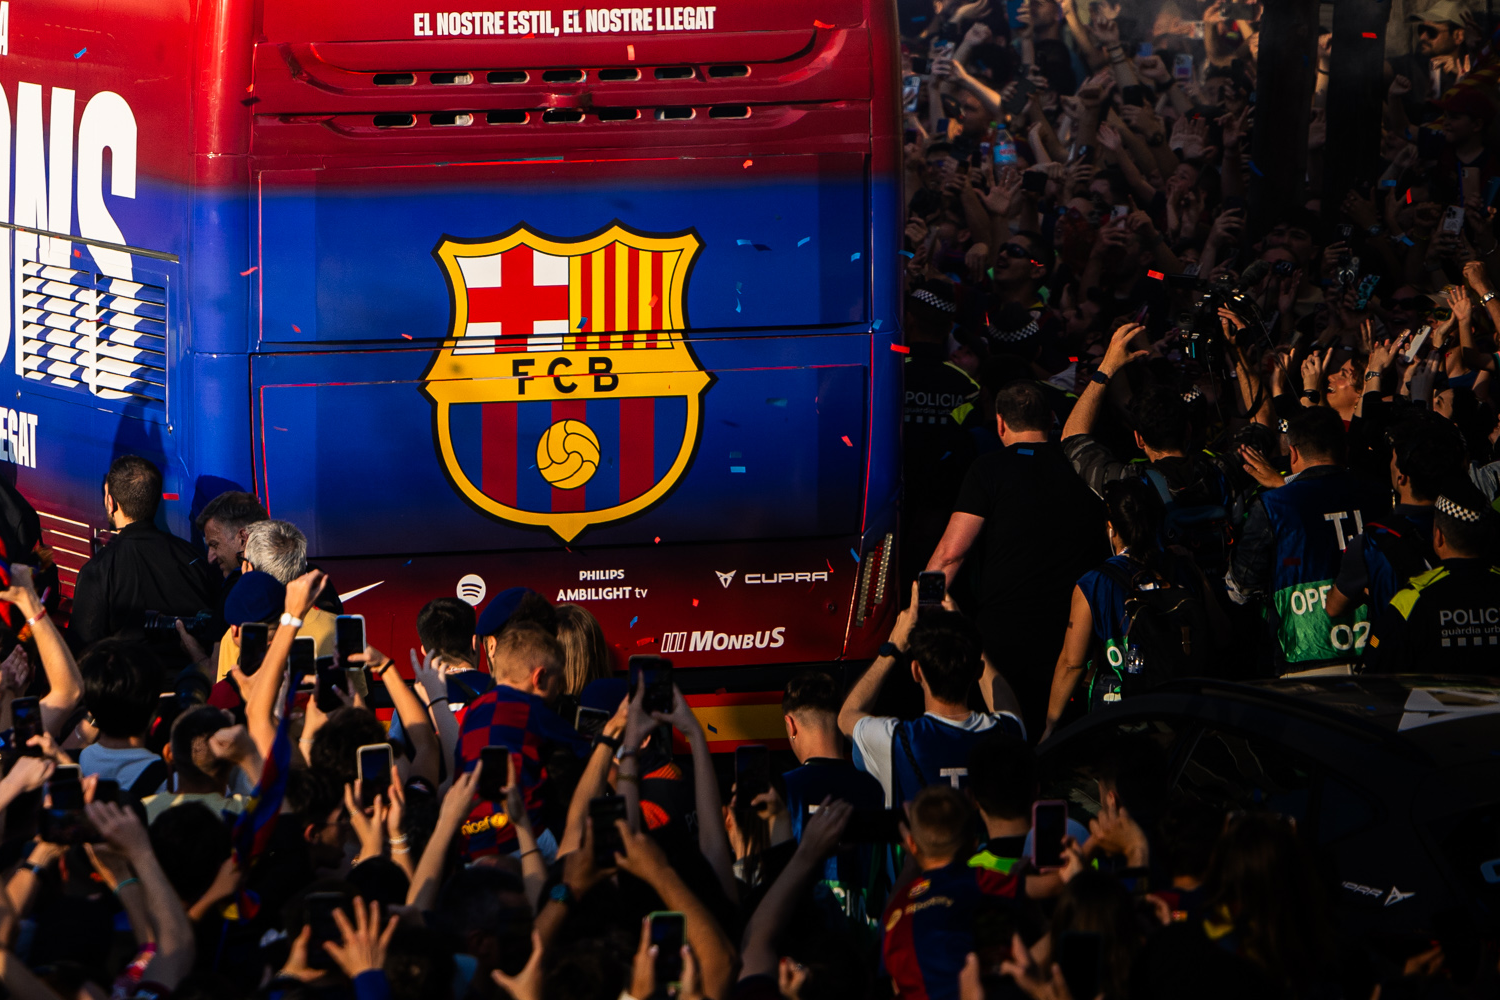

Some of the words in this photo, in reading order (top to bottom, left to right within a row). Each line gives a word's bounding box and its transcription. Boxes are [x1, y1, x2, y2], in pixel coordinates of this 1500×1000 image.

[414, 12, 433, 36] EL
[436, 11, 504, 36] NOSTRE
[508, 10, 560, 37] ESTIL,
[564, 10, 582, 33] EL
[586, 8, 653, 33] NOSTRE
[656, 7, 715, 31] LLEGAT
[512, 356, 619, 396] FCB
[905, 390, 963, 407] POLICIA
[579, 569, 625, 581] PHILIPS
[744, 571, 829, 584] CUPRA
[557, 586, 632, 602] AMBILIGHT
[635, 587, 648, 599] tv
[1439, 607, 1500, 626] POLIC
[1441, 626, 1481, 637] guàrdia
[1484, 626, 1500, 635] urb
